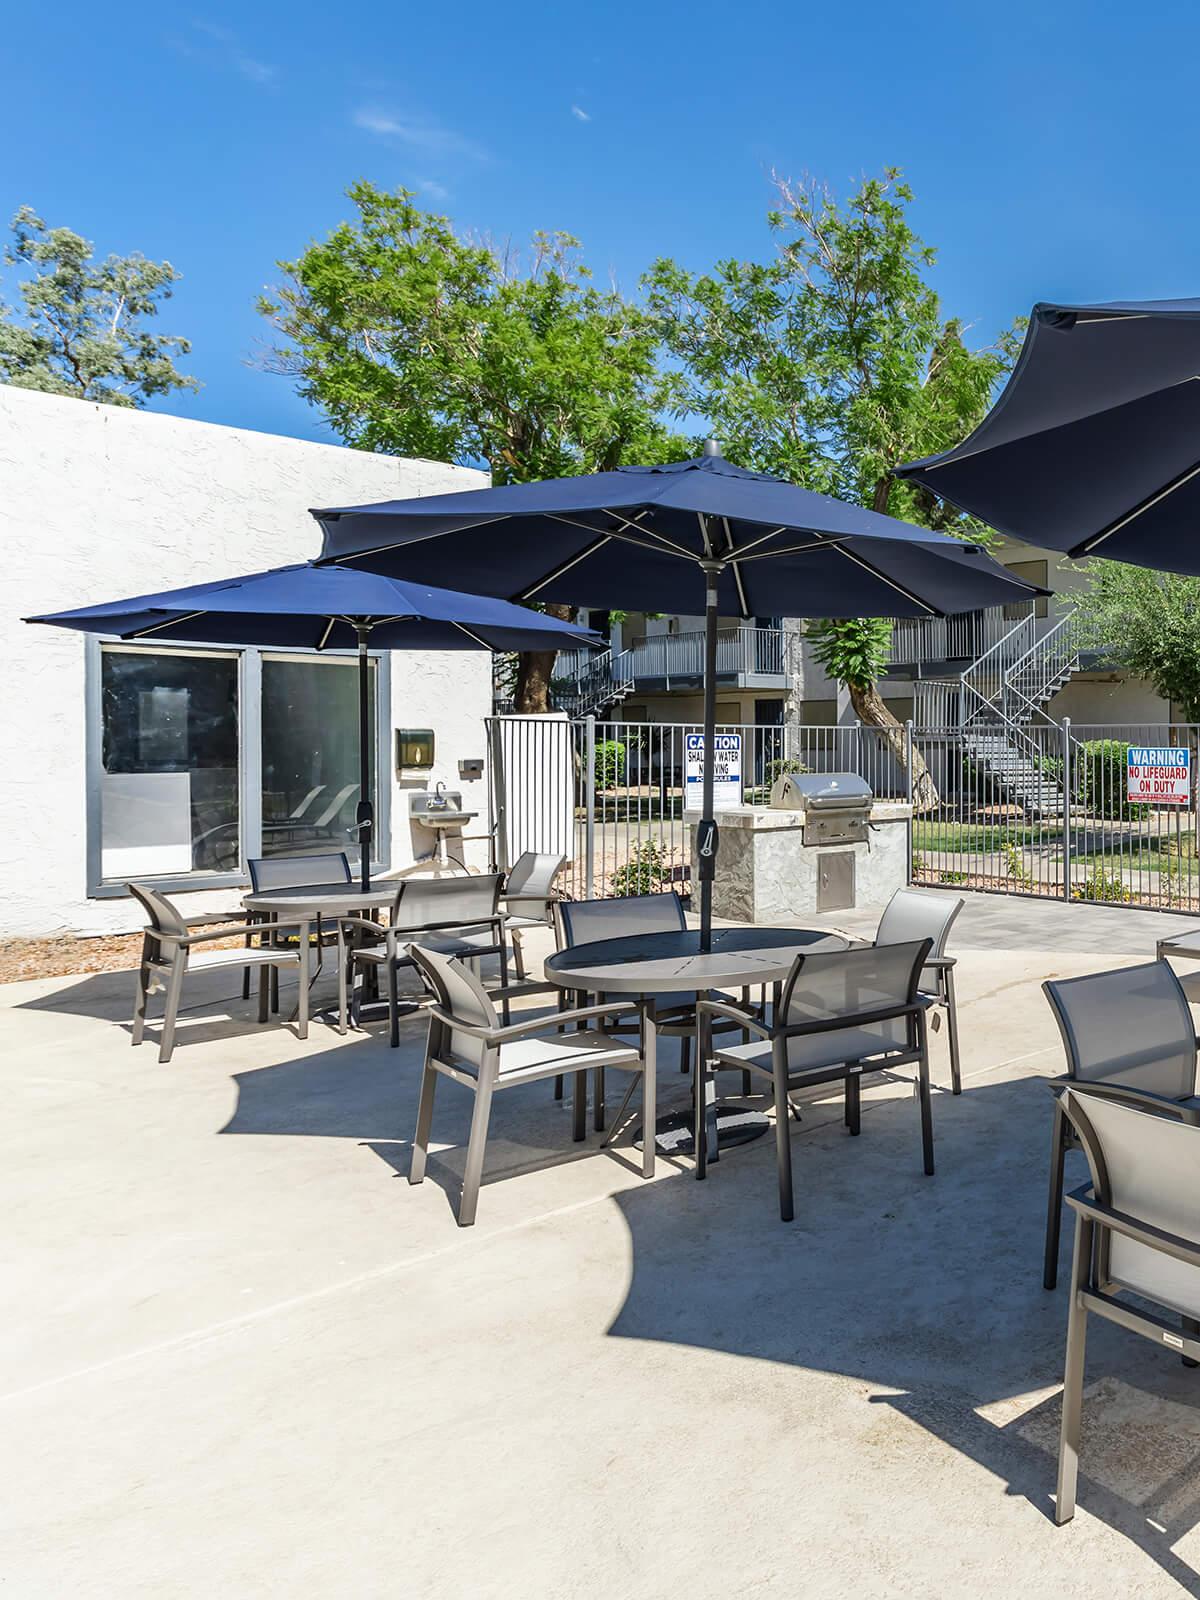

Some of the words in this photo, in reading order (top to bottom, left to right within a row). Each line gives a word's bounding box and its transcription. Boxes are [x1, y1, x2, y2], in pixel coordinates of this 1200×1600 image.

[689, 738, 738, 748] CATION
[719, 752, 738, 762] WATER
[1132, 750, 1184, 765] WARNING
[714, 764, 728, 774] VING
[1129, 767, 1139, 778] NO
[1143, 767, 1187, 779] LIFEGUARD
[1140, 780, 1150, 792] ON
[1154, 781, 1175, 793] DUTY
